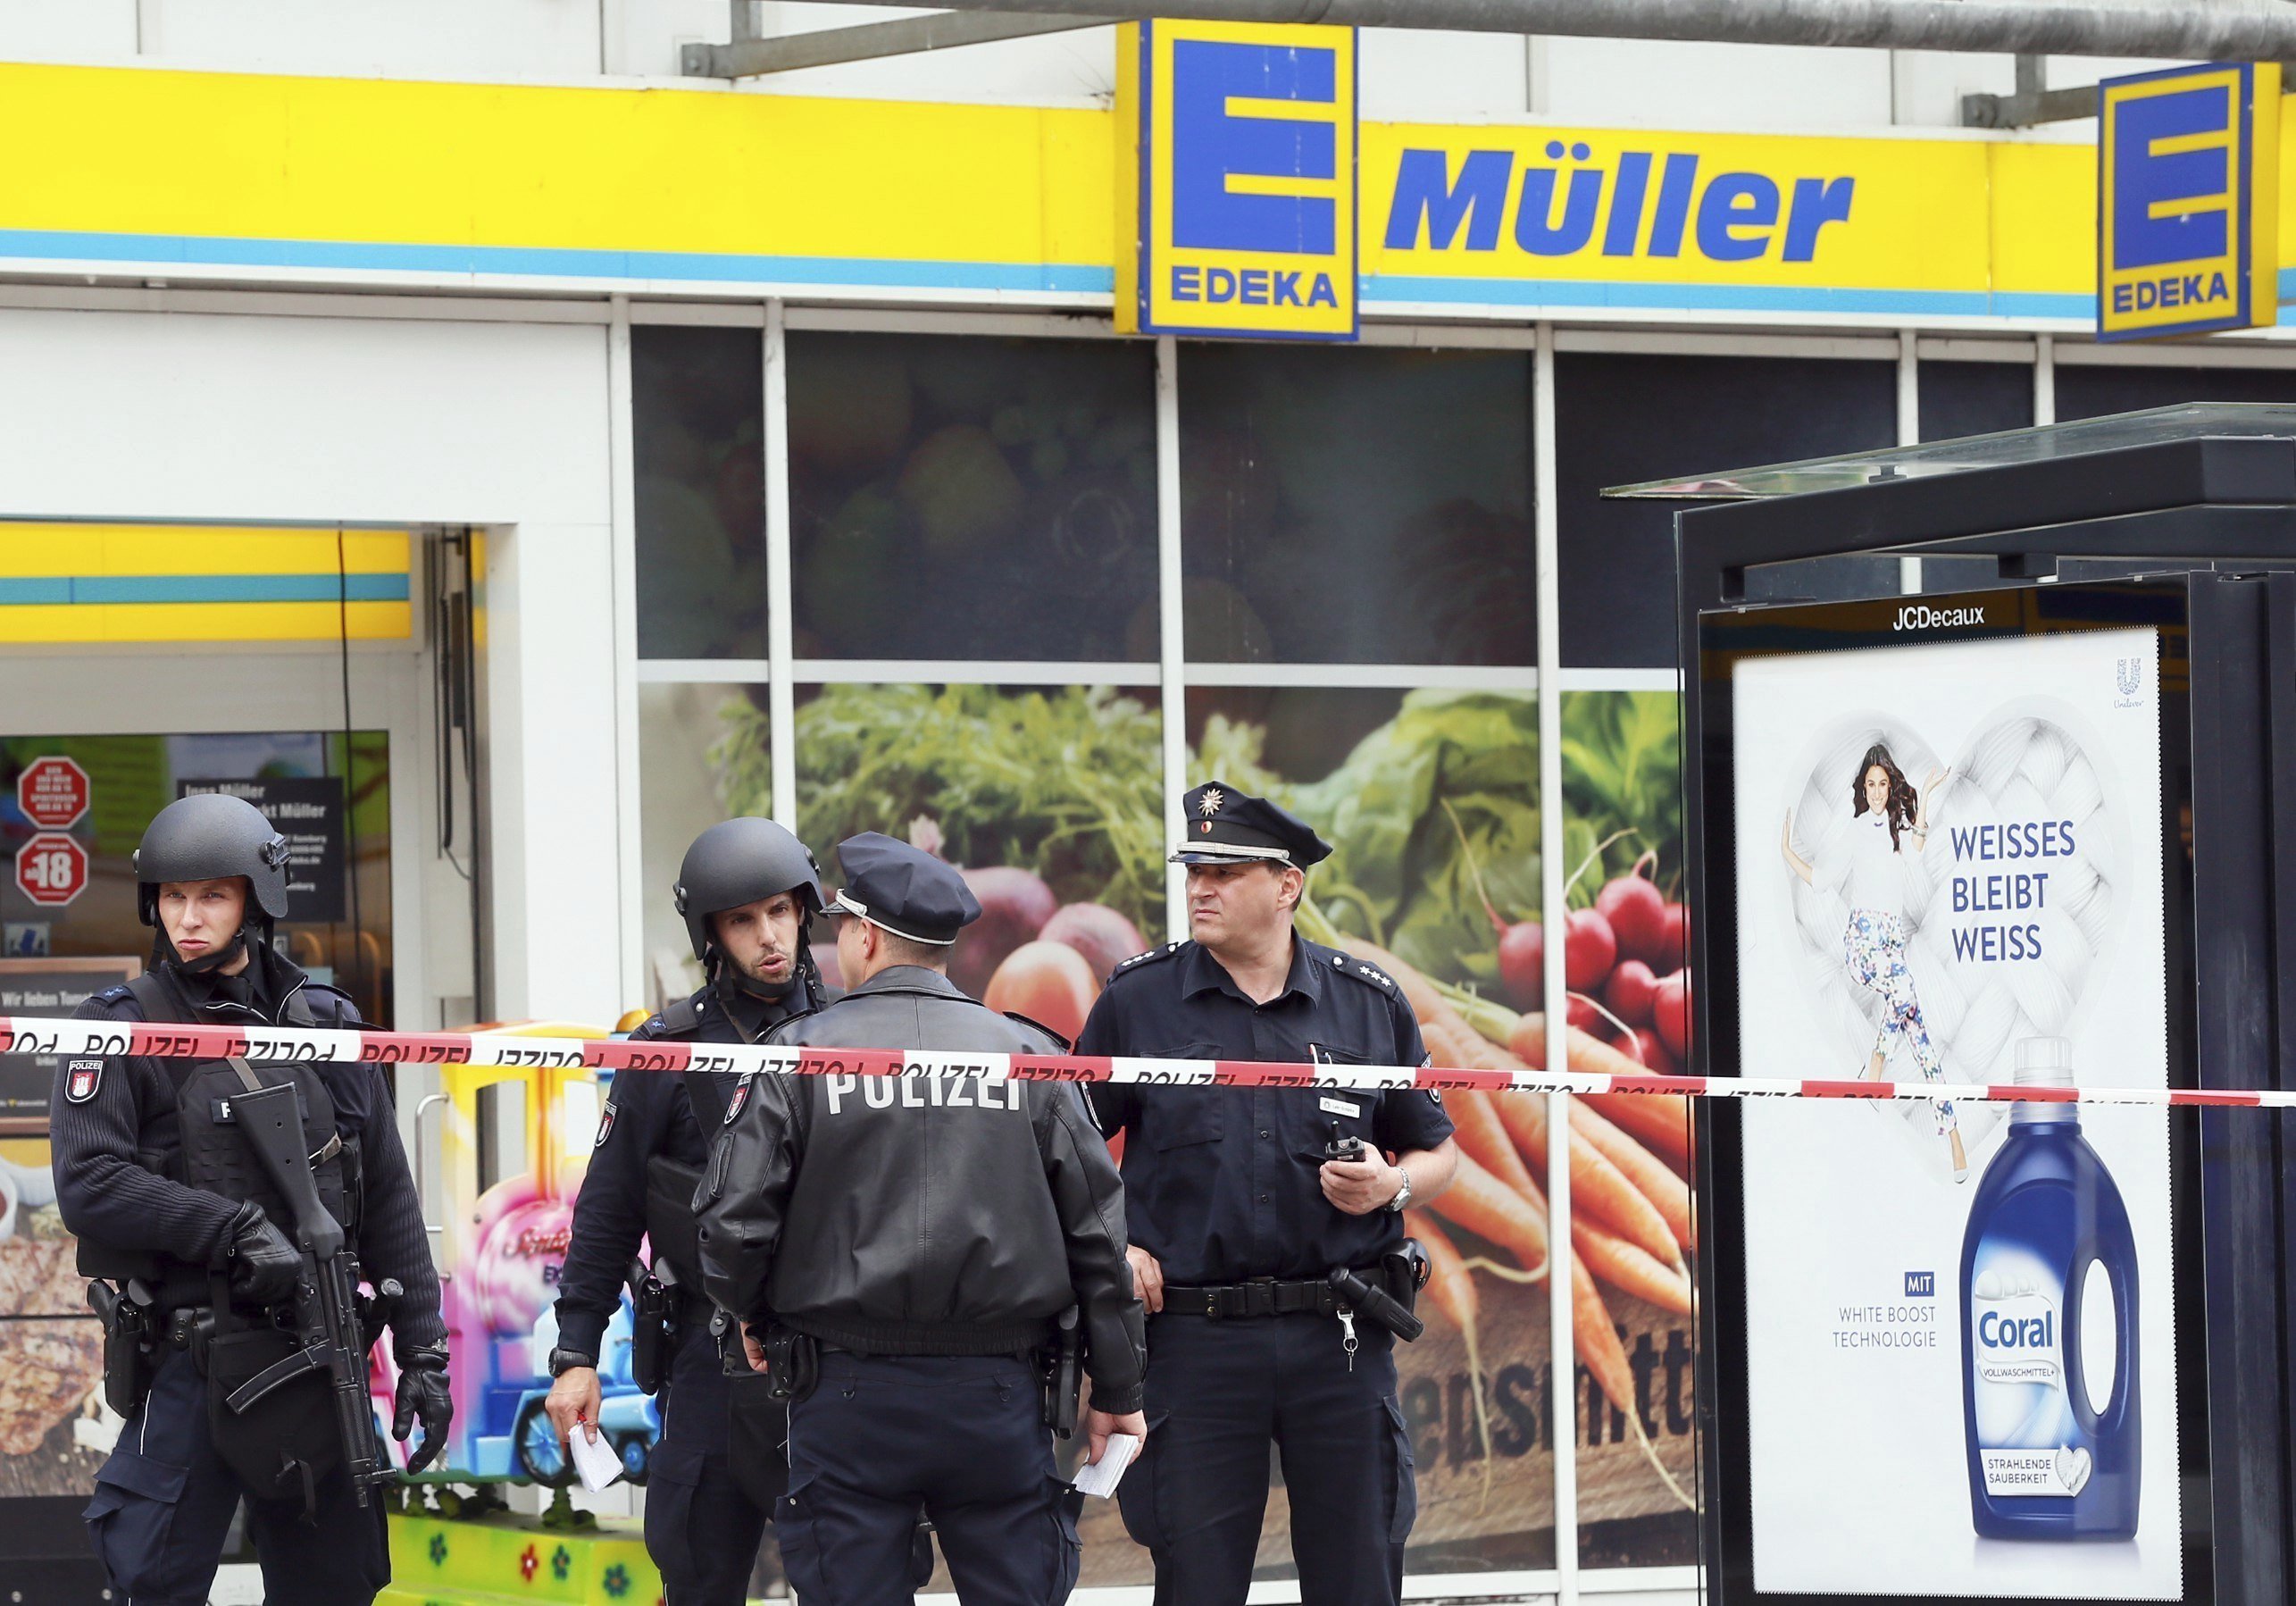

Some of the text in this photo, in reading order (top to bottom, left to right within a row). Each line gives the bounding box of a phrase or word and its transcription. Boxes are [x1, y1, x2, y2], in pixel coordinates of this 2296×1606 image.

[1173, 38, 1336, 255] E
[2113, 85, 2230, 271] E
[1384, 140, 1855, 263] Müller
[1171, 264, 1339, 308] EDEKA
[2113, 272, 2230, 314] EDEKA
[1892, 606, 1985, 632] JCDecaux
[1950, 820, 2075, 862] WEISSES
[31, 851, 72, 889] 18
[1952, 872, 2049, 912] BLEIBT
[1951, 924, 2042, 963] WEISS
[71, 1062, 102, 1071] POLIZEI
[826, 1074, 1021, 1115] POLIZEI
[1908, 1276, 1932, 1292] MIT
[1839, 1306, 1936, 1323] WHITE BOOST
[1979, 1310, 2053, 1349] Coral
[1833, 1331, 1937, 1348] TECHNOLOGIE
[1988, 1459, 2051, 1470] STRAHLENDE
[1989, 1473, 2048, 1485] SAUBERKEIT
